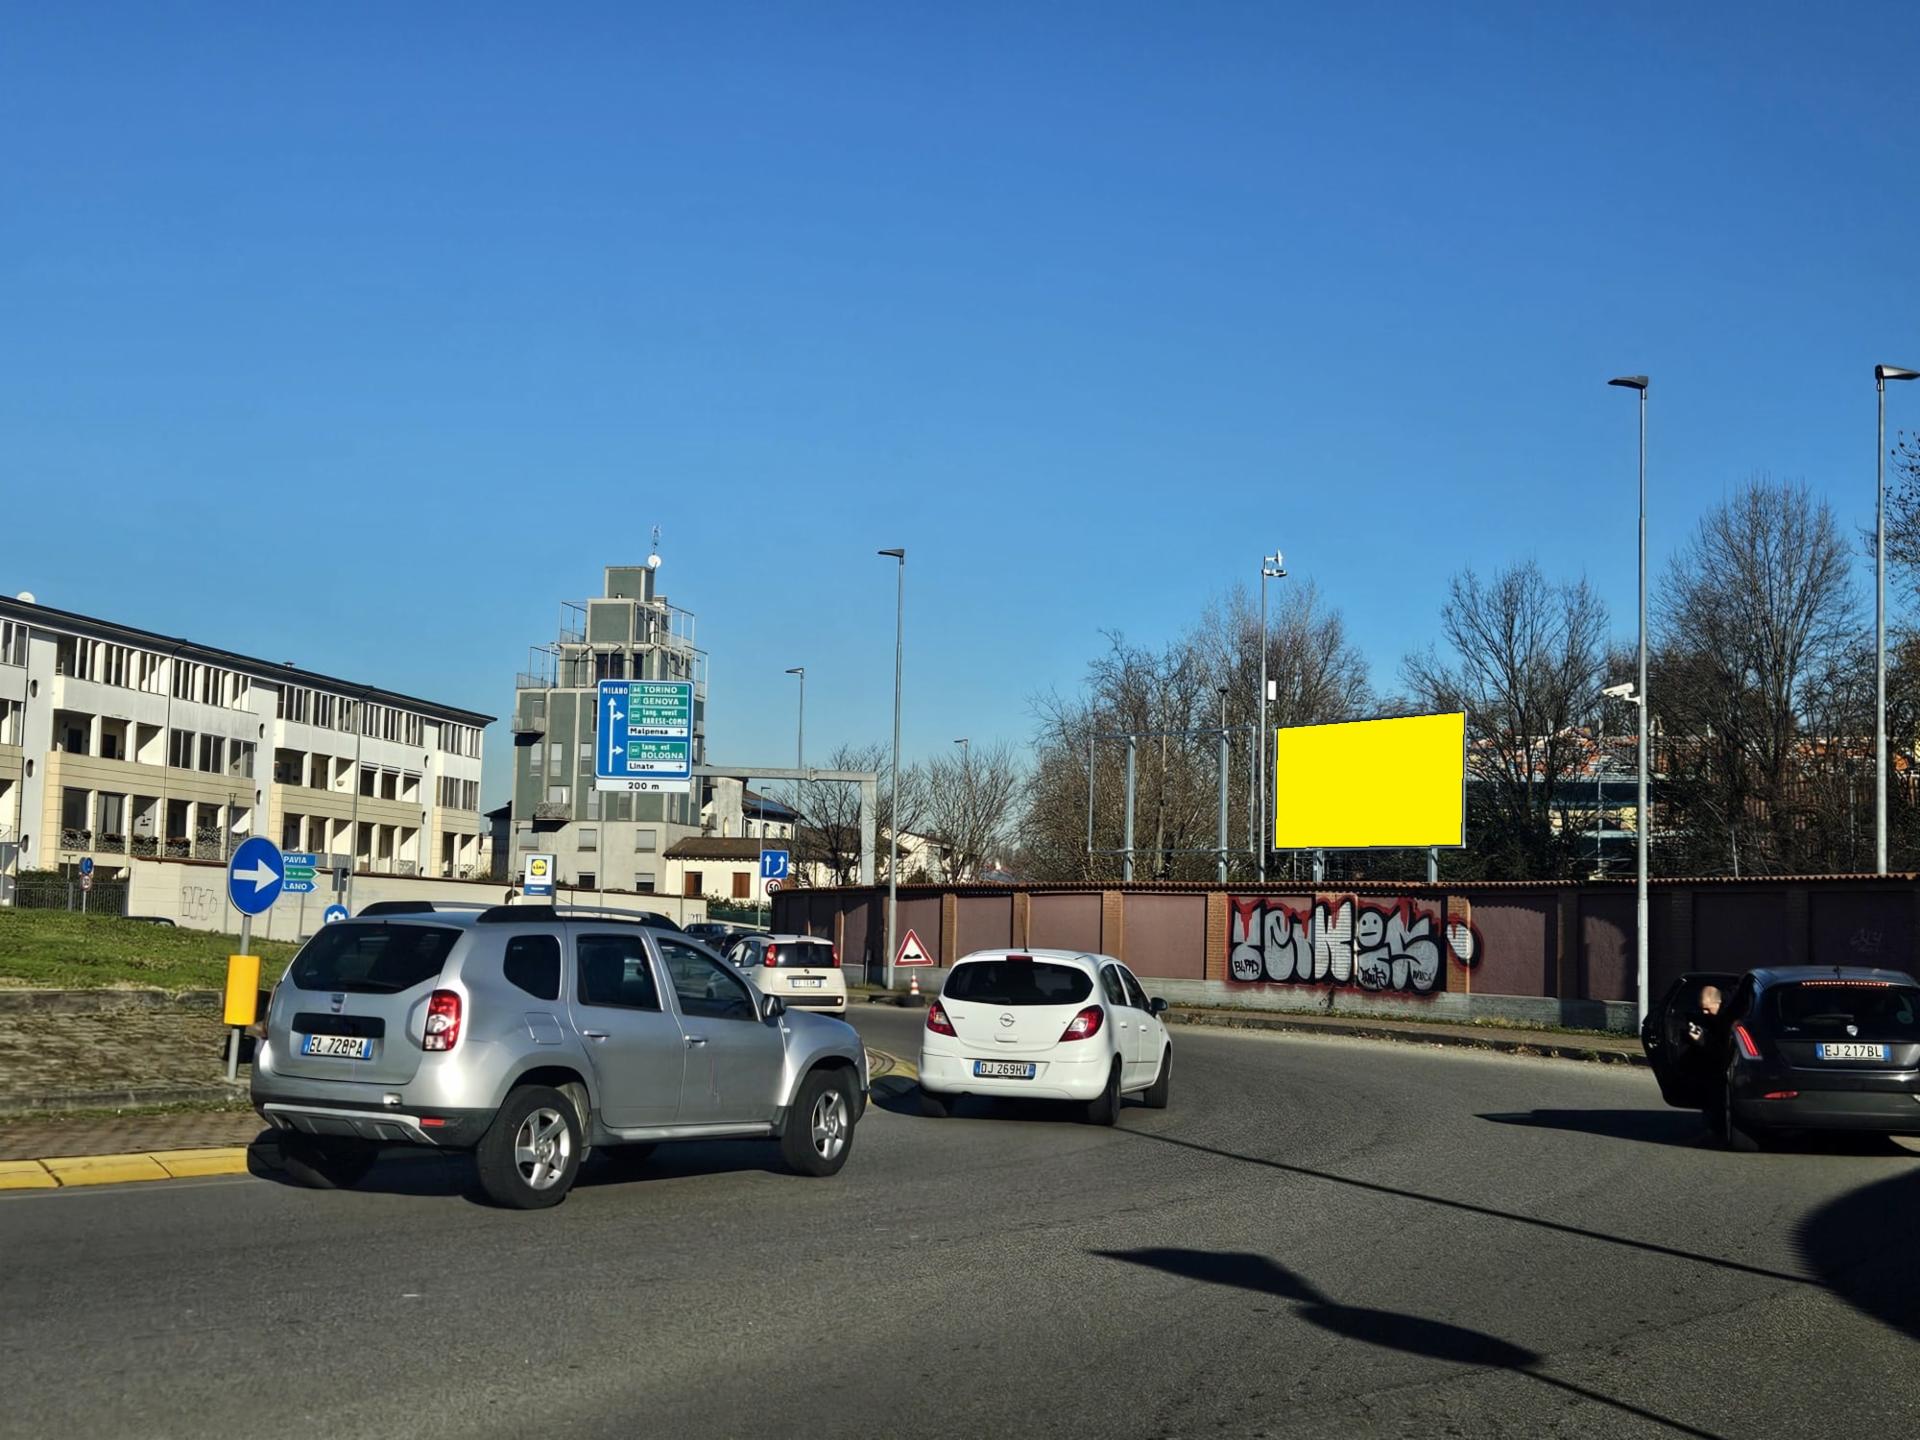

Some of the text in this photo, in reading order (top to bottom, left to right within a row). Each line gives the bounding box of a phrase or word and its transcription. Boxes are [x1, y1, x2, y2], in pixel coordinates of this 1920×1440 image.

[602, 686, 628, 695] MILANO
[643, 686, 678, 694] TORINO
[642, 697, 679, 705] GENOVA
[641, 717, 687, 725] VARESE-COMO
[629, 727, 669, 736] Malpensa
[641, 751, 684, 760] BOLOGNA
[629, 762, 655, 770] Linate
[628, 782, 647, 790] 200
[283, 855, 307, 864] PAVIA
[284, 882, 307, 890] LANO
[769, 883, 779, 892] 50
[309, 1036, 363, 1056] EL 728PA
[1824, 1044, 1882, 1058] EJ 217BL
[980, 1063, 1028, 1076] DJ 269HV
